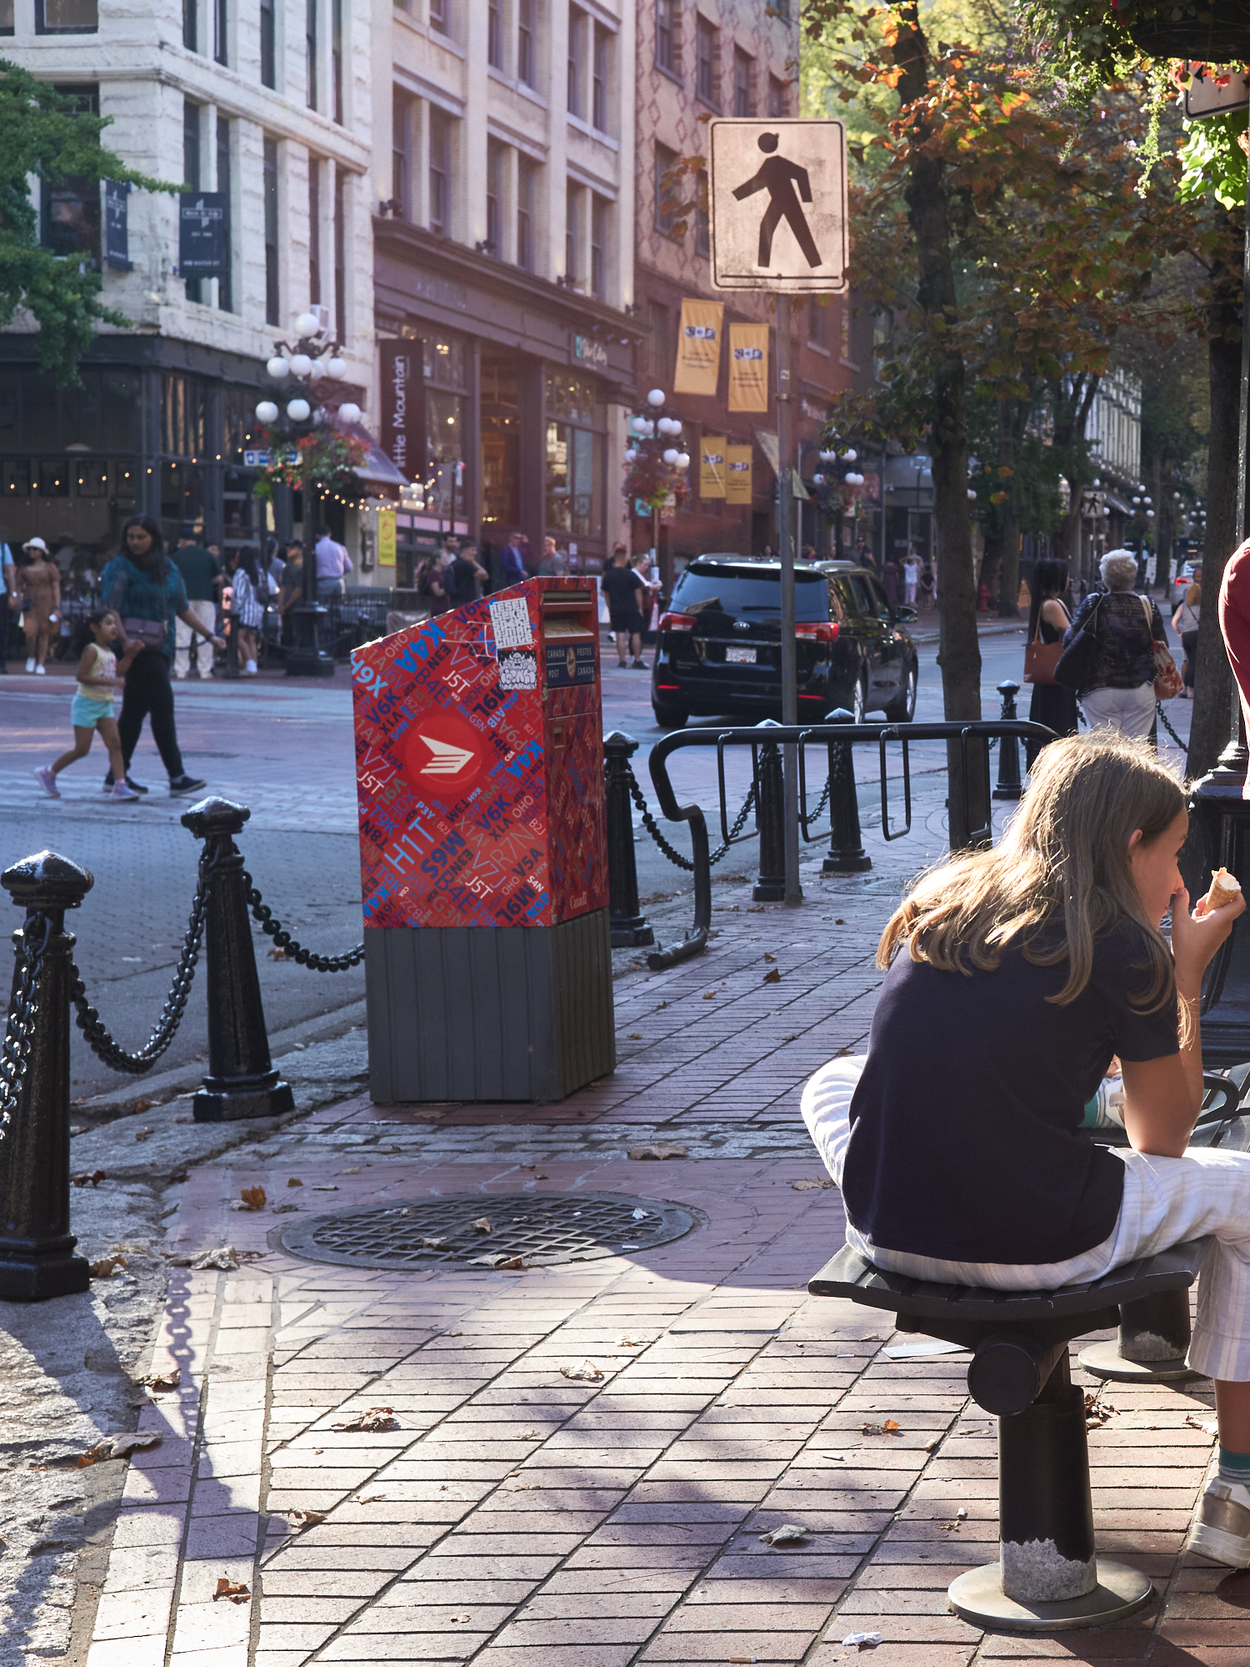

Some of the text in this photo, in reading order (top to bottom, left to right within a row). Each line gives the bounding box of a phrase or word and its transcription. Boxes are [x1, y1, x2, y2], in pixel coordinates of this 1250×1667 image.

[391, 355, 407, 429] Mountain
[393, 620, 447, 674] K4A
[426, 643, 452, 670] E3N
[460, 638, 494, 668] J6W
[547, 649, 565, 659] CANADA
[378, 664, 411, 689] J6V
[450, 646, 484, 684] V7J
[548, 668, 560, 678] POST
[577, 666, 594, 676] CANADA
[414, 666, 450, 704] B4E
[442, 669, 470, 694] J5T
[356, 695, 372, 714] S7P
[364, 687, 402, 724] V6K
[404, 695, 425, 716] B2Z
[456, 703, 472, 718] G6X
[502, 691, 519, 711] N5P
[514, 697, 542, 724] L7C
[378, 711, 403, 736] V1X
[469, 713, 487, 732] G5N
[487, 706, 506, 728] A1B
[523, 722, 536, 736] B2J
[390, 720, 410, 741] S4N
[488, 730, 512, 756] T4H
[498, 718, 529, 752] P9A
[379, 737, 395, 755] P8T
[504, 750, 516, 762] C0A
[504, 738, 545, 778] K4A
[363, 746, 397, 784] V7J
[386, 752, 404, 771] V5A
[488, 759, 507, 778] V0N
[529, 758, 545, 775] E3N
[357, 771, 385, 795] J5T
[376, 777, 408, 805] V9L
[467, 786, 482, 803] K6H
[478, 784, 500, 803] V9L
[494, 773, 521, 794] J6V
[518, 773, 545, 799] B4E
[387, 788, 419, 820] X0E
[415, 800, 436, 820] P3Y
[431, 799, 449, 815] E4P
[445, 799, 471, 823] T3M
[466, 803, 480, 820] S7P
[474, 793, 513, 831] V6K
[369, 803, 400, 837] T9K
[436, 820, 451, 835] B2J
[455, 815, 484, 847] X1A
[488, 817, 514, 842] V1X
[528, 818, 547, 836] B2J
[360, 818, 389, 852] T8N
[384, 815, 435, 875] H1T
[489, 822, 535, 871] R7N
[420, 829, 467, 881] M6S
[449, 848, 475, 876] E3N
[511, 847, 545, 877] V5A
[376, 863, 405, 896] T9K
[401, 869, 433, 894] J6V
[456, 868, 473, 885] Y1A
[472, 850, 507, 889] V7J
[533, 861, 549, 877] K6H
[434, 869, 479, 915] B4E
[465, 875, 494, 899] J5T
[526, 875, 545, 893] S4N
[363, 884, 391, 918] K4A
[375, 898, 397, 925] J6W
[399, 895, 423, 920] B2Z
[433, 896, 468, 928] G3N
[494, 882, 537, 923] M9L
[525, 892, 550, 920] N5P
